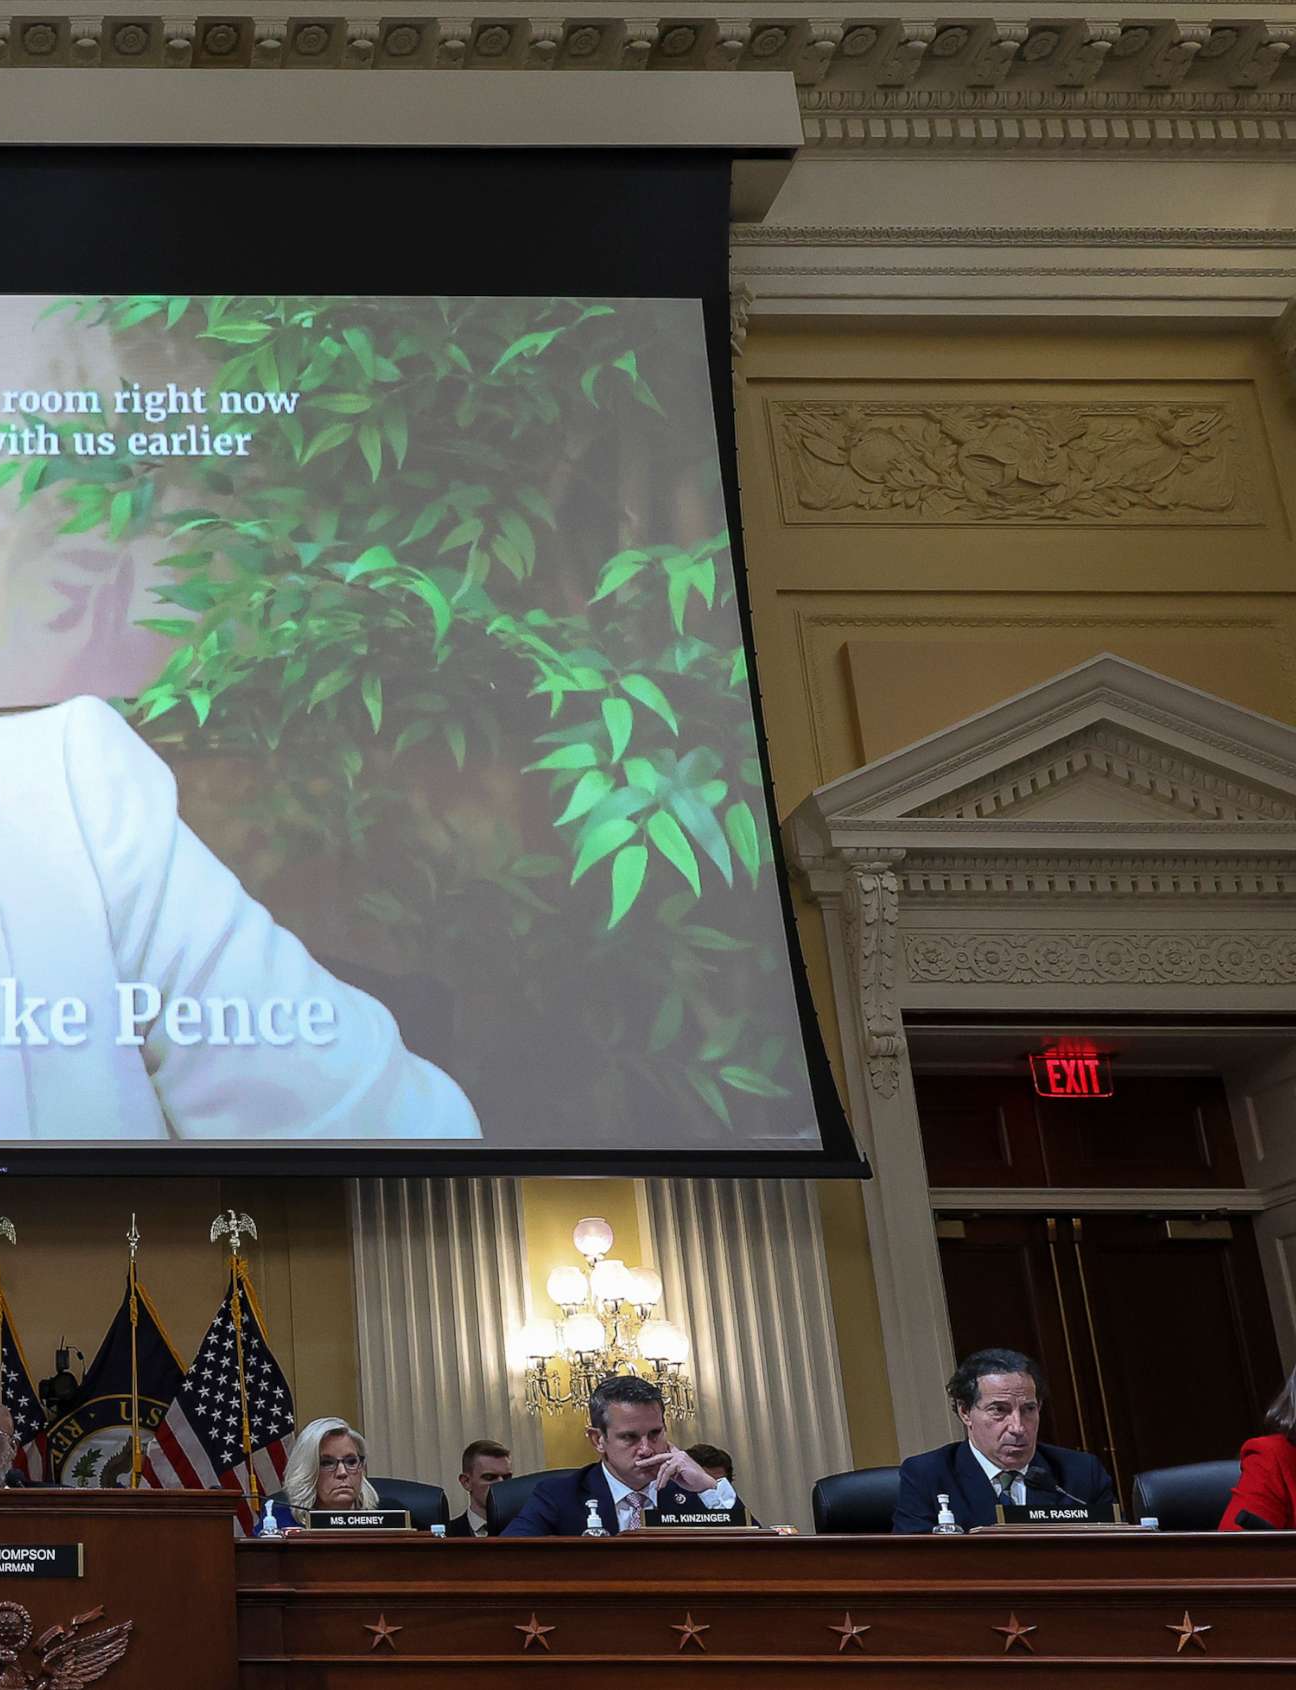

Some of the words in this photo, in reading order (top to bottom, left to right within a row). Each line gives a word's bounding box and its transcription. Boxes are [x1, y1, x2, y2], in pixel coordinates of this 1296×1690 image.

[2, 392, 102, 413] room
[114, 382, 207, 423] right
[219, 392, 300, 414] now
[72, 434, 116, 455] us
[127, 425, 253, 456] earlier
[114, 980, 338, 1047] Pence
[1046, 1060, 1101, 1093] EXIT
[330, 1516, 347, 1525] MS.
[347, 1516, 384, 1525] CHENEY
[661, 1514, 679, 1523] MR.
[680, 1513, 731, 1523] KINZINGER
[1028, 1510, 1049, 1519] MR.
[1050, 1509, 1089, 1518] RASKIN
